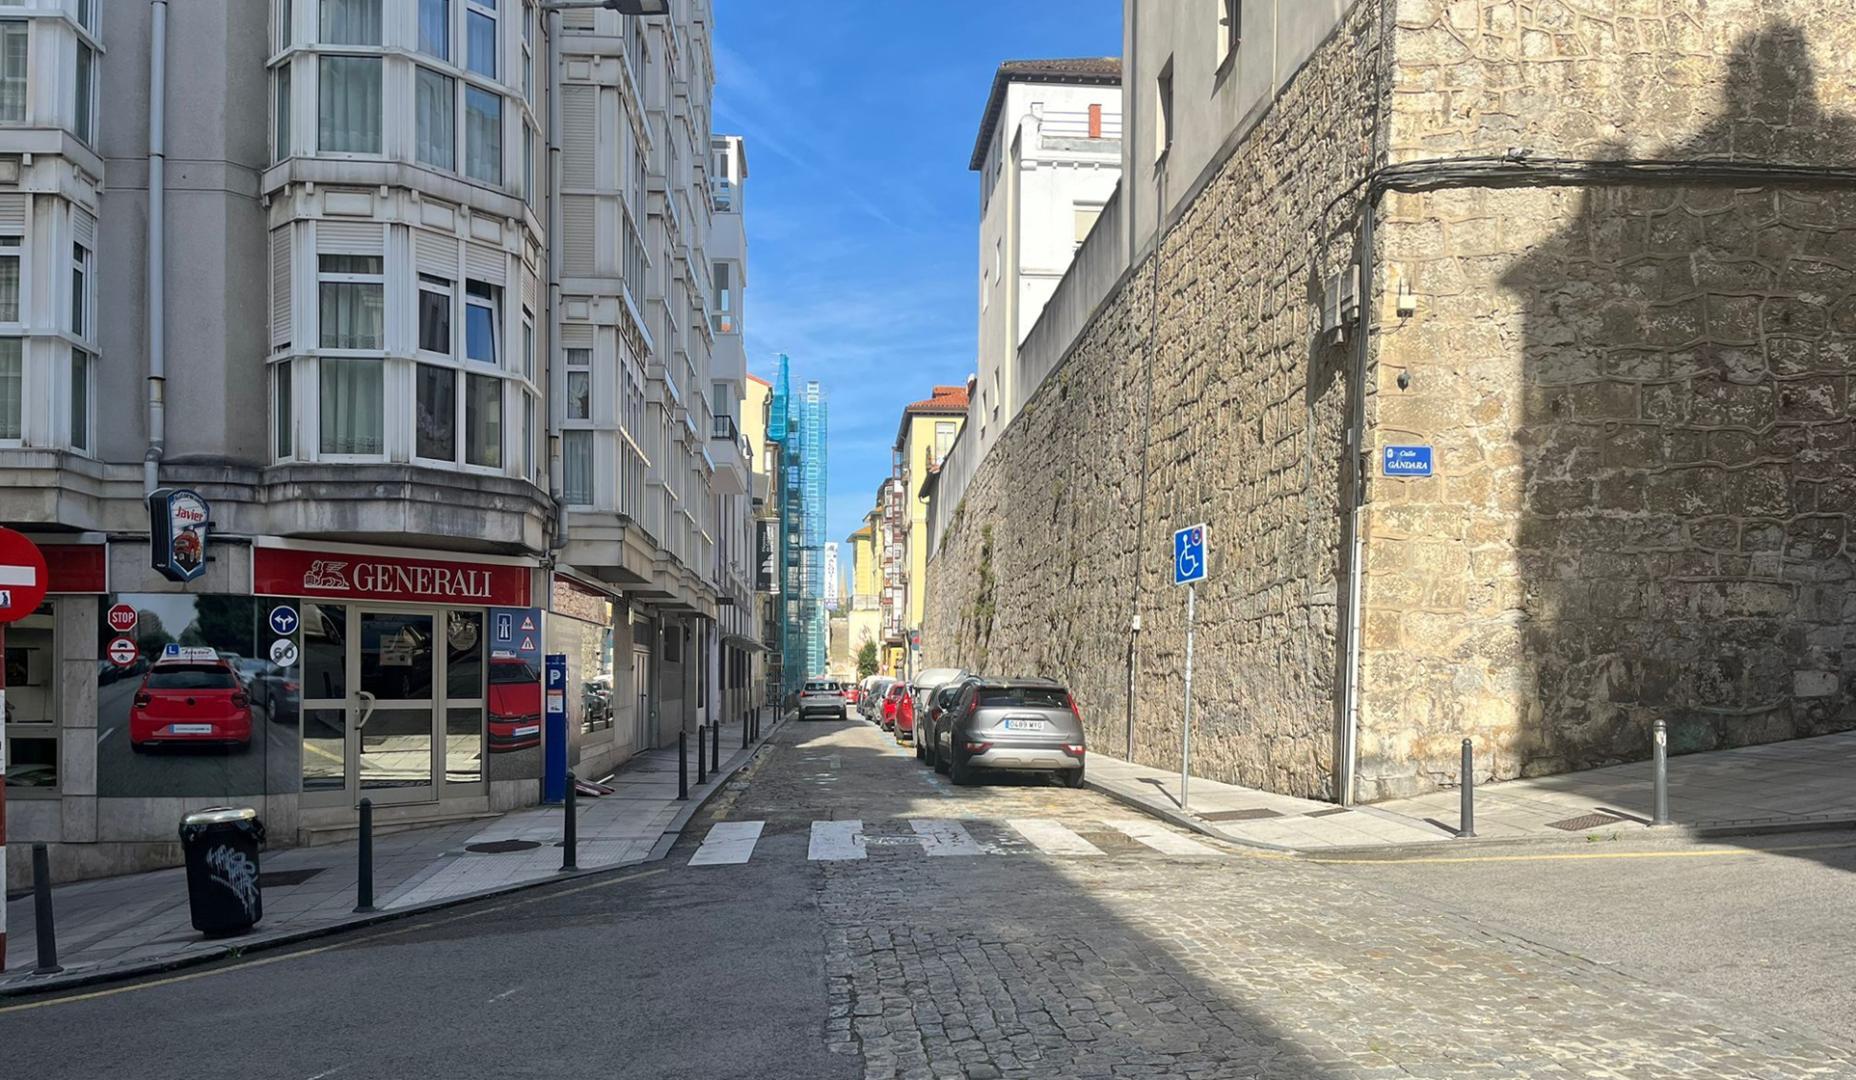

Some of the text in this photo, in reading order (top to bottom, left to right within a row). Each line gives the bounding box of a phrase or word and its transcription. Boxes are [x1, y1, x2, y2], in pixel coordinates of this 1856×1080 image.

[1388, 459, 1428, 469] GÁNDARA
[175, 506, 203, 521] Javier
[353, 563, 492, 598] GENERALI
[112, 612, 134, 623] STOP
[168, 646, 177, 654] L
[274, 647, 294, 659] 60
[550, 669, 561, 685] P
